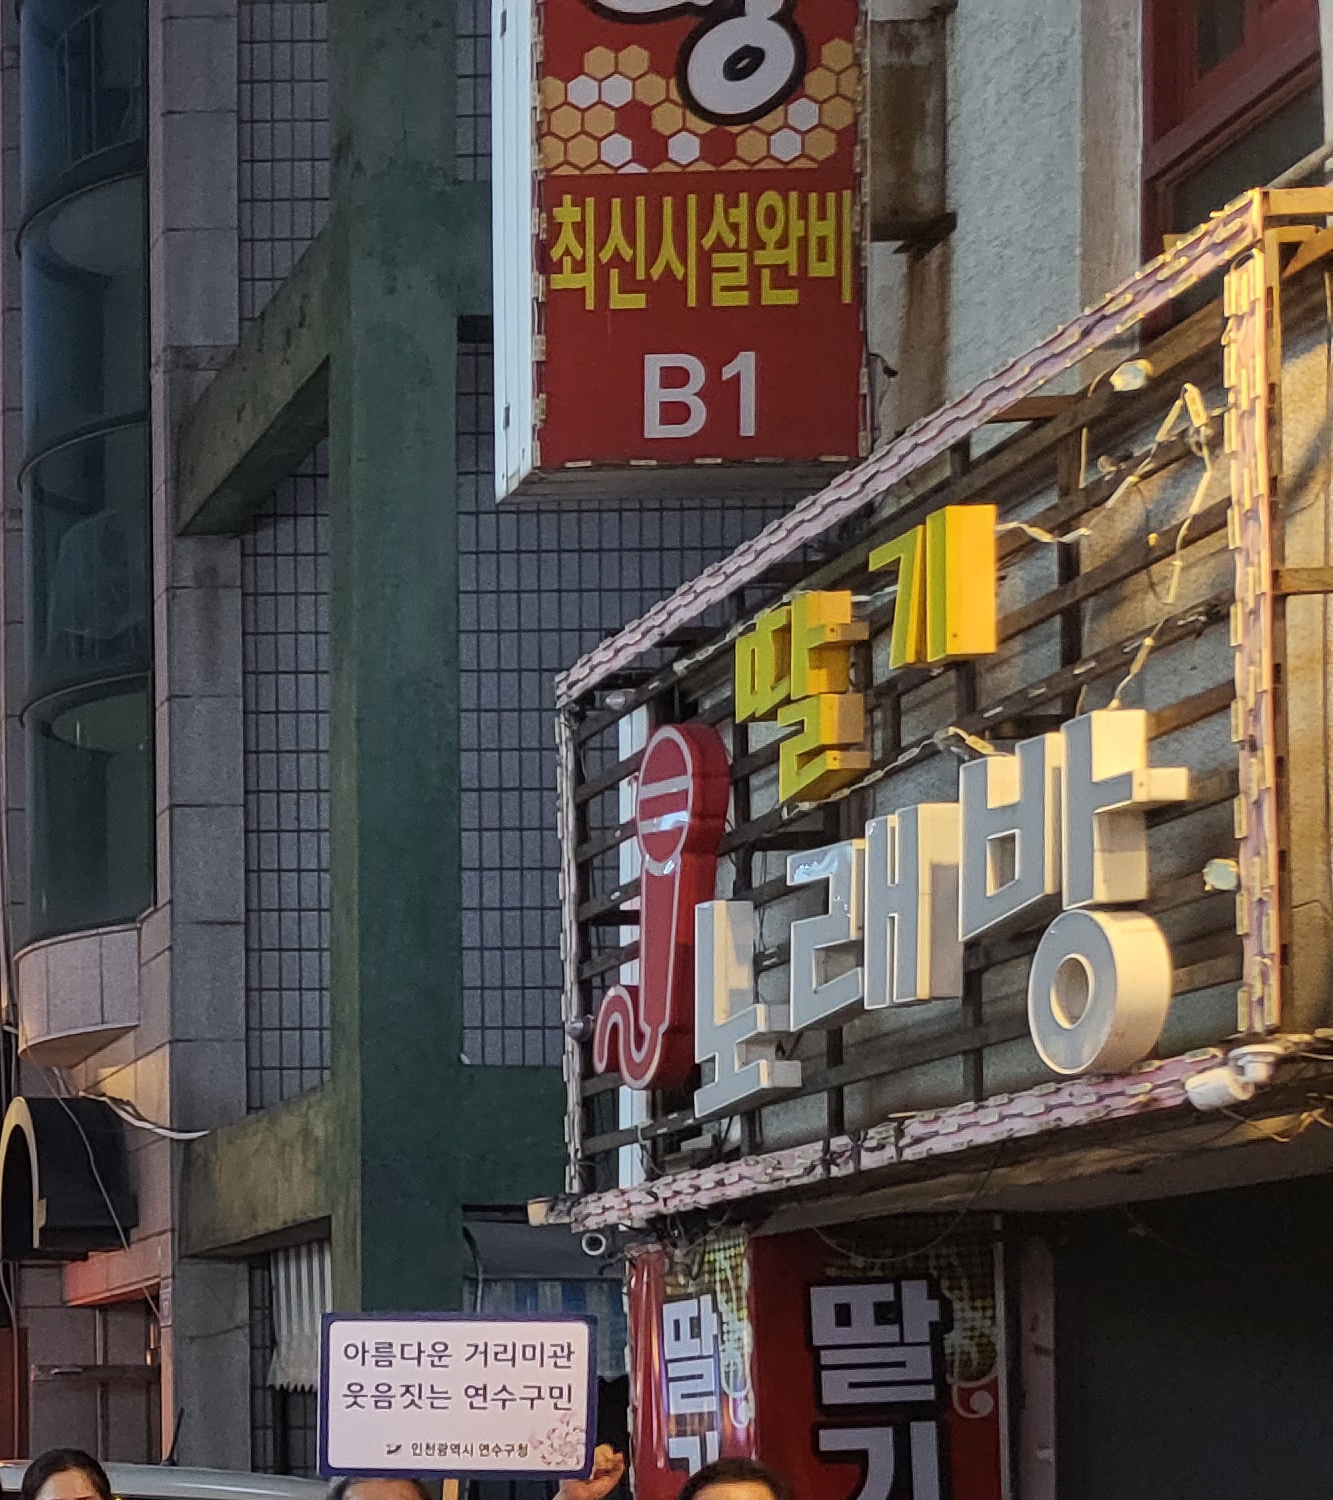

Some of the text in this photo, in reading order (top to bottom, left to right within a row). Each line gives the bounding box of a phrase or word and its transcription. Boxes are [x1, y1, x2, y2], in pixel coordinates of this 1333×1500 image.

[549, 189, 852, 311] 최신시설완비
[642, 351, 757, 439] B1
[735, 503, 998, 803] 딸기
[693, 709, 1190, 1118] 노래방
[342, 1340, 575, 1369] 아름다운 거리미관
[342, 1382, 573, 1411] 웃음짓는 연수구민
[410, 1442, 529, 1458] 인천광역시 연수구청
